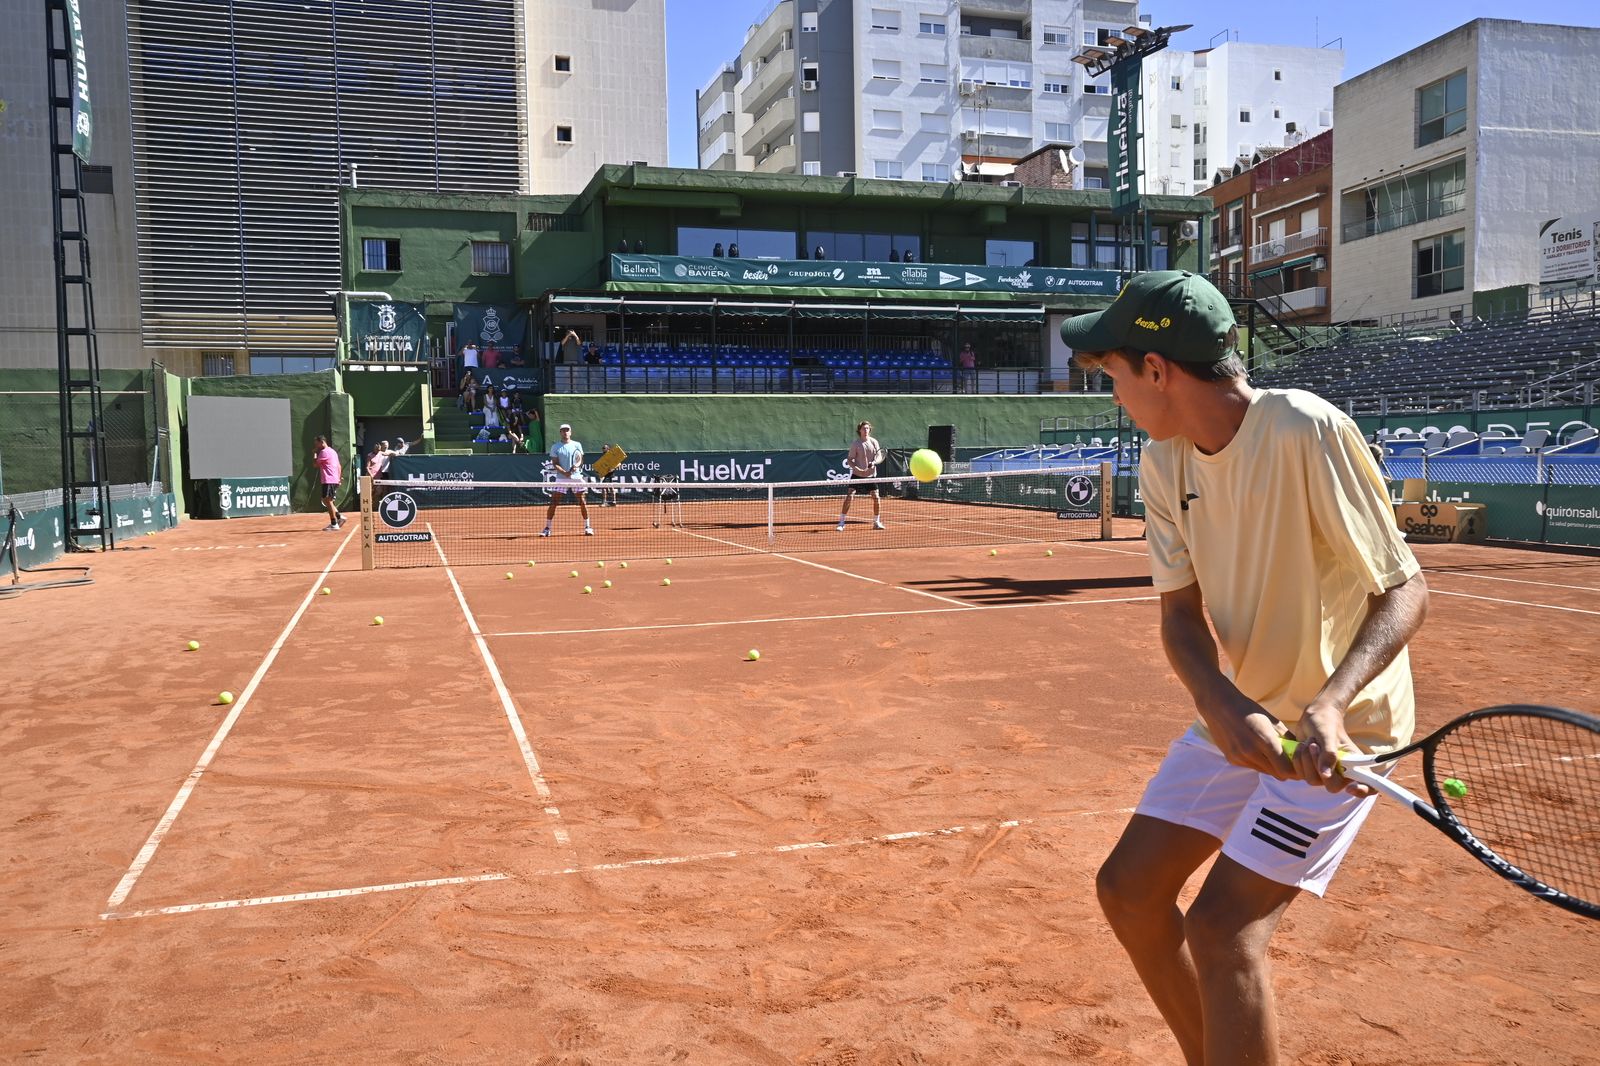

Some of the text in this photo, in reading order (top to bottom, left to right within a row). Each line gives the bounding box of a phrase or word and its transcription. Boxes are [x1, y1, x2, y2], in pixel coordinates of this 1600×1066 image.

[1113, 92, 1129, 192] Huelva
[1551, 228, 1582, 243] Tenis
[365, 341, 413, 351] HUELVA
[650, 460, 660, 471] de
[680, 458, 764, 481] Huelva
[427, 470, 474, 480] DIPUTACIÓN
[235, 484, 288, 494] Ayuntamiento de
[236, 494, 290, 509] HUELVA
[1405, 517, 1456, 541] Seabery
[378, 534, 429, 542] AUTOGOTRAN
